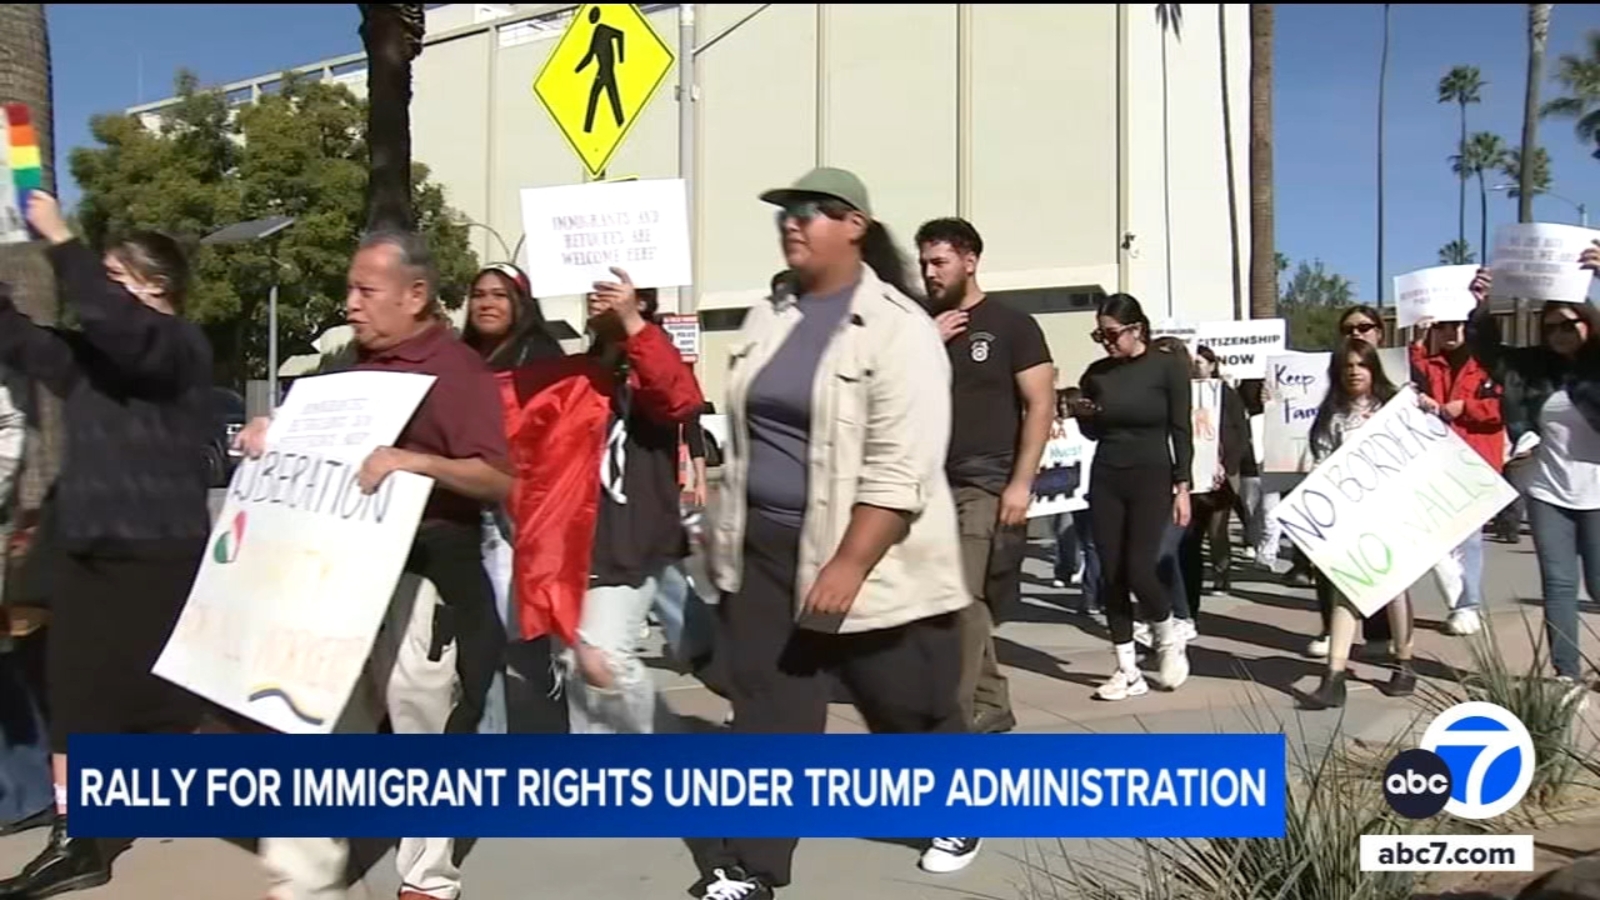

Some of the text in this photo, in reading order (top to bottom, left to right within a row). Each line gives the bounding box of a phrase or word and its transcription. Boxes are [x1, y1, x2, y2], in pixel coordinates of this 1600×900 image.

[552, 210, 660, 230] IMMIGRANTS AND
[561, 249, 620, 266] WELCOME
[1198, 334, 1281, 348] CITIZENSHIP
[1216, 353, 1255, 366] NOW
[1274, 363, 1316, 395] Keep
[1277, 406, 1450, 551] NO BORDERS
[1330, 532, 1393, 597] NO
